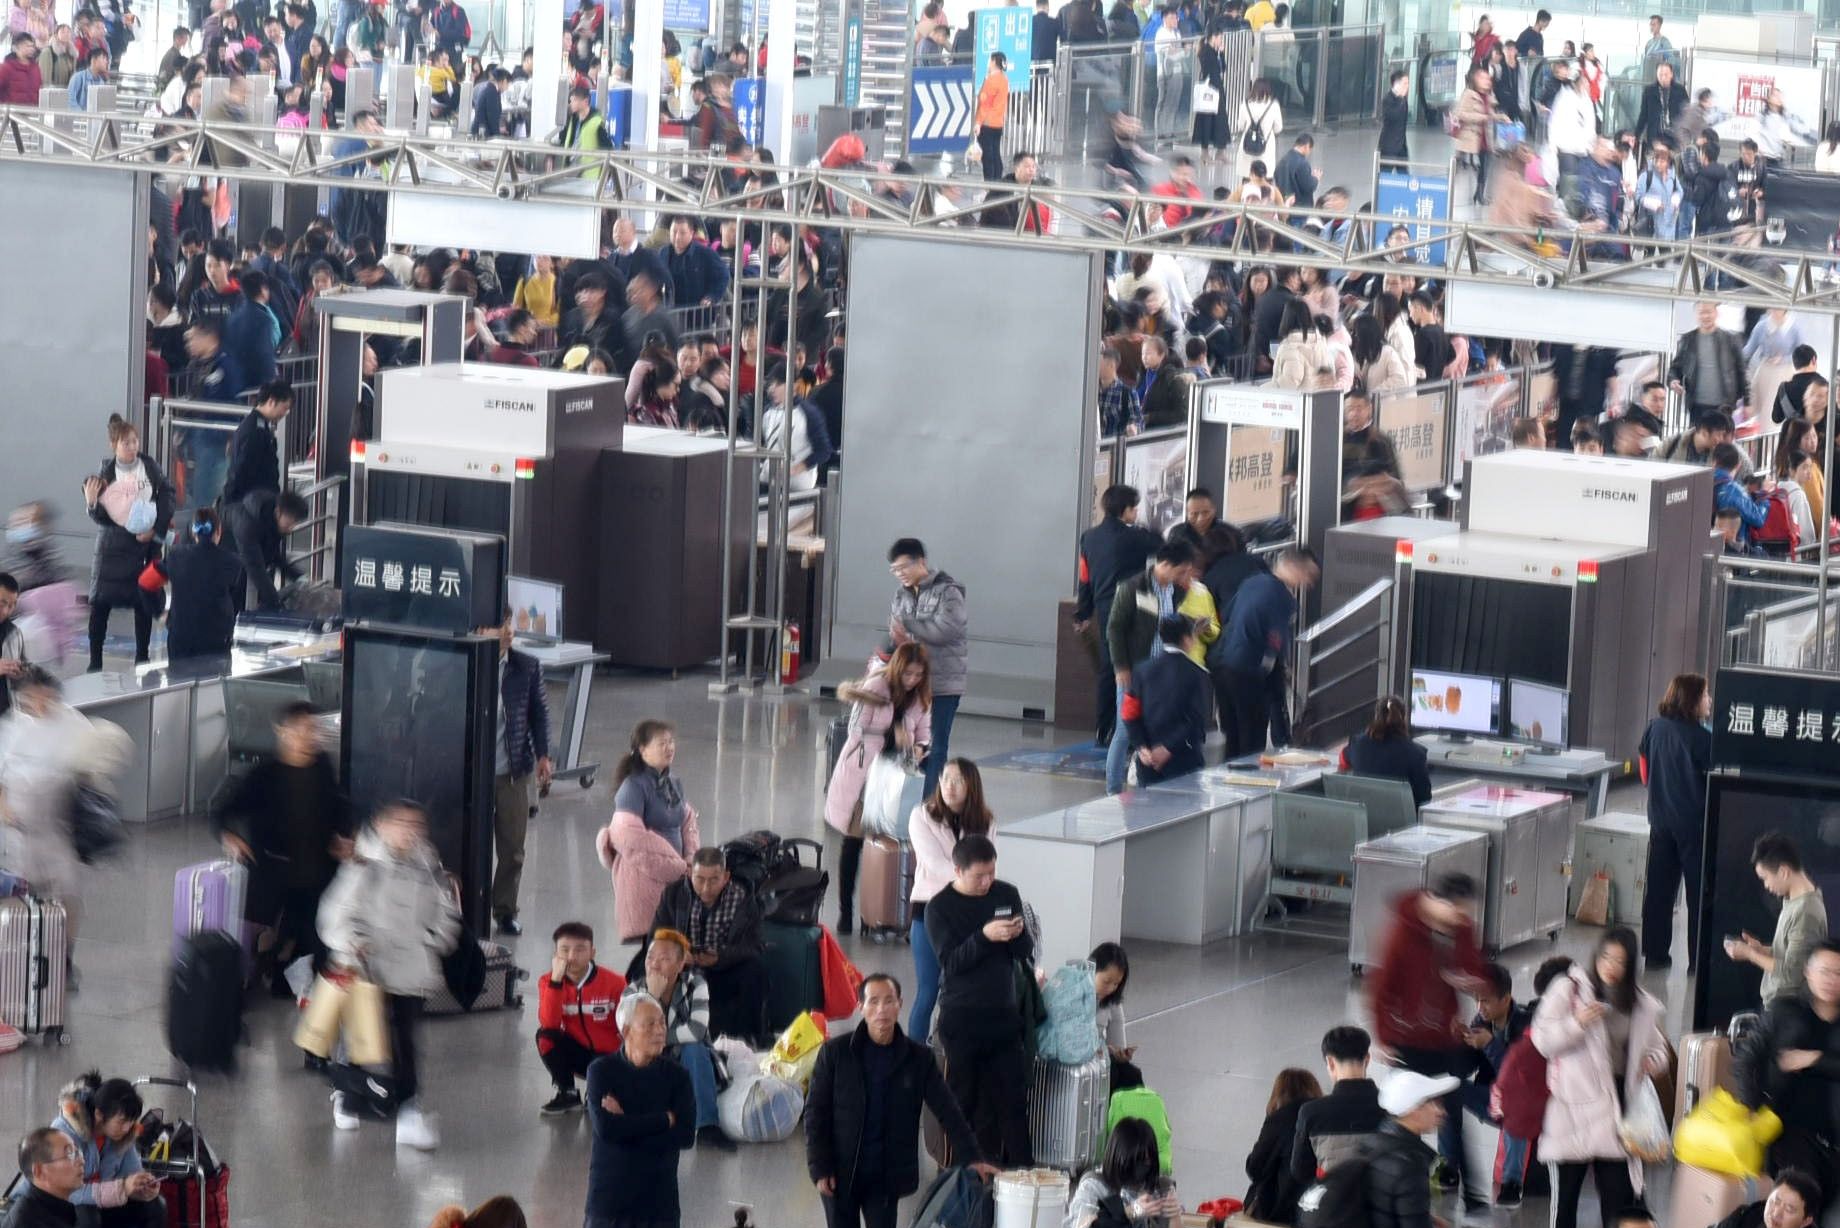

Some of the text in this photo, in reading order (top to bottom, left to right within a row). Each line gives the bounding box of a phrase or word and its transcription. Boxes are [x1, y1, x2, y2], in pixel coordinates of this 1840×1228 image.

[495, 399, 534, 412] FISCAN
[571, 398, 594, 412] FISCAN
[1594, 488, 1636, 502] FISCAN
[354, 555, 461, 598] 温馨提示
